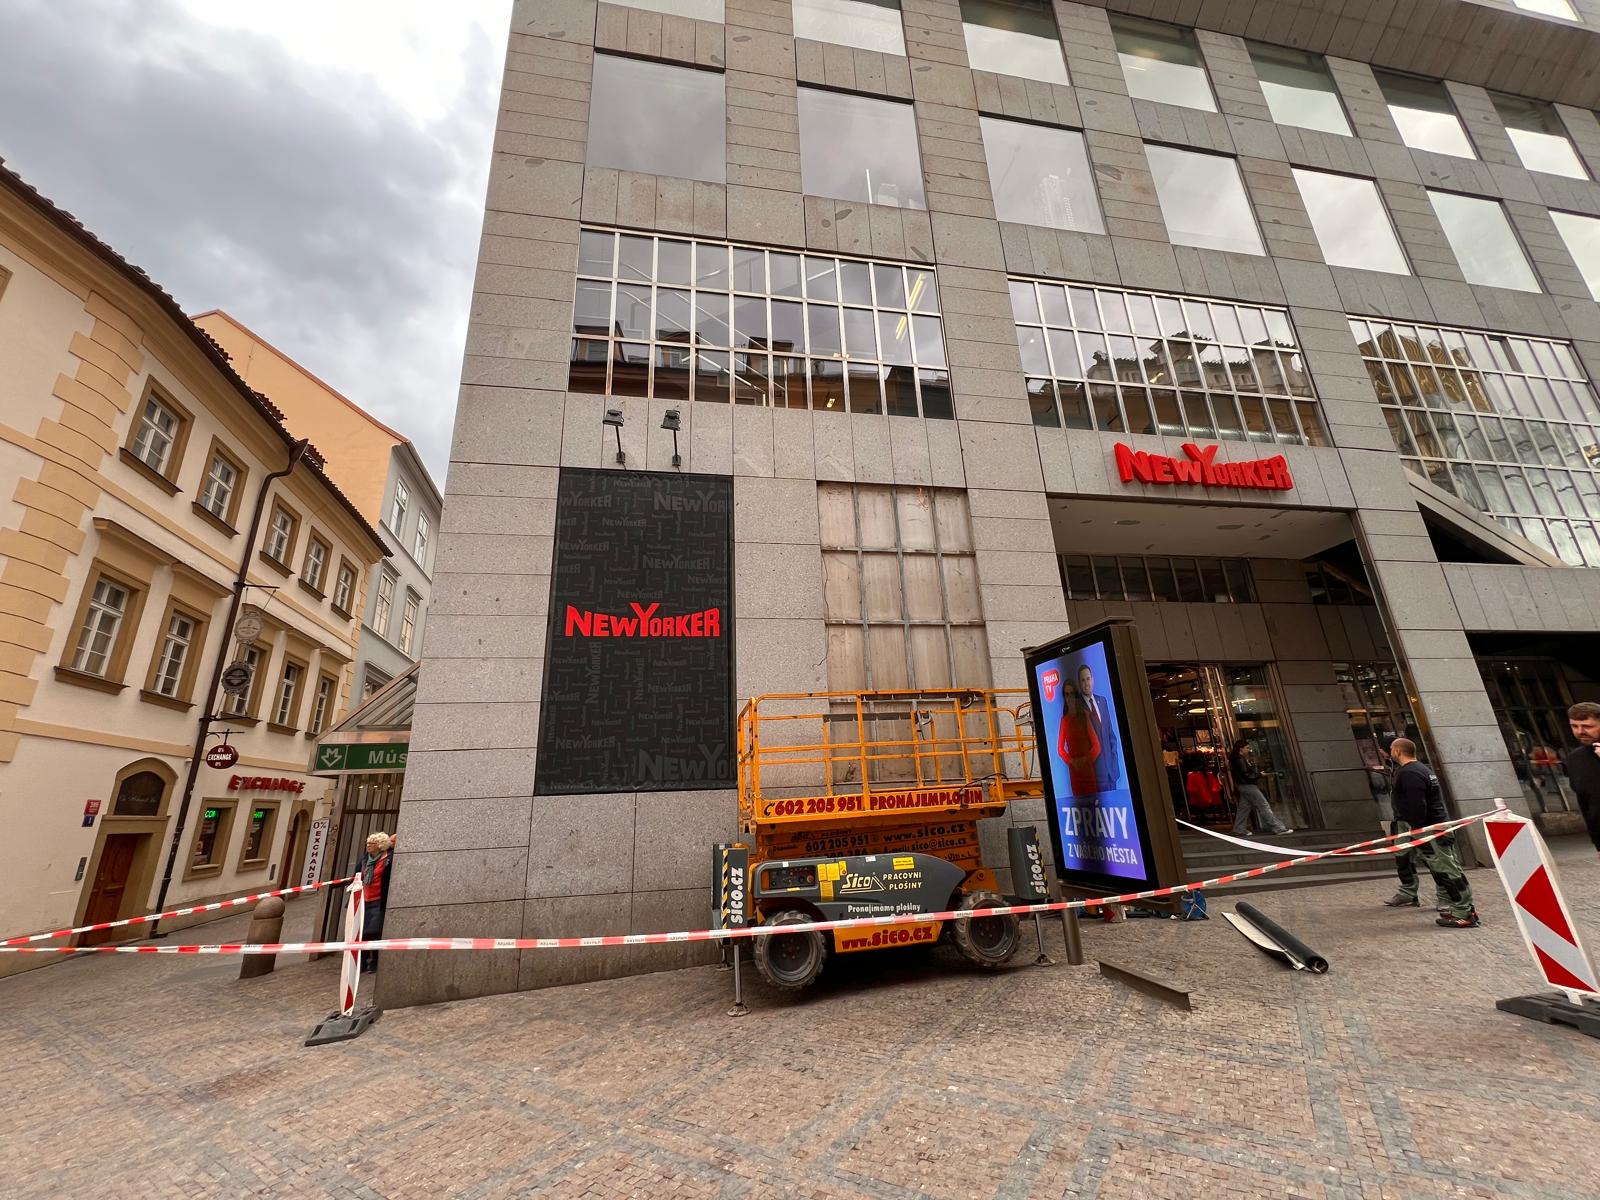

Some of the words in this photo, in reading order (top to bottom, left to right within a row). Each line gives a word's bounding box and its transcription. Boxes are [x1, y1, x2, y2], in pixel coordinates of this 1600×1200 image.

[207, 753, 233, 761] EXCHANGE
[228, 774, 306, 794] EXCHANGE
[774, 800, 804, 816] 602
[806, 798, 835, 814] 205
[837, 796, 862, 811] 951
[313, 821, 327, 830] 0%
[1062, 800, 1129, 840] ZPRÁVY
[883, 823, 966, 842] www.sico.cz
[806, 841, 826, 852] 602
[828, 837, 849, 850] 205
[850, 834, 869, 846] 951
[1106, 843, 1138, 865] MĚSTA
[1026, 844, 1047, 894] sico.cz
[889, 880, 922, 890] PLOŠINY
[726, 867, 744, 924] sico.cz
